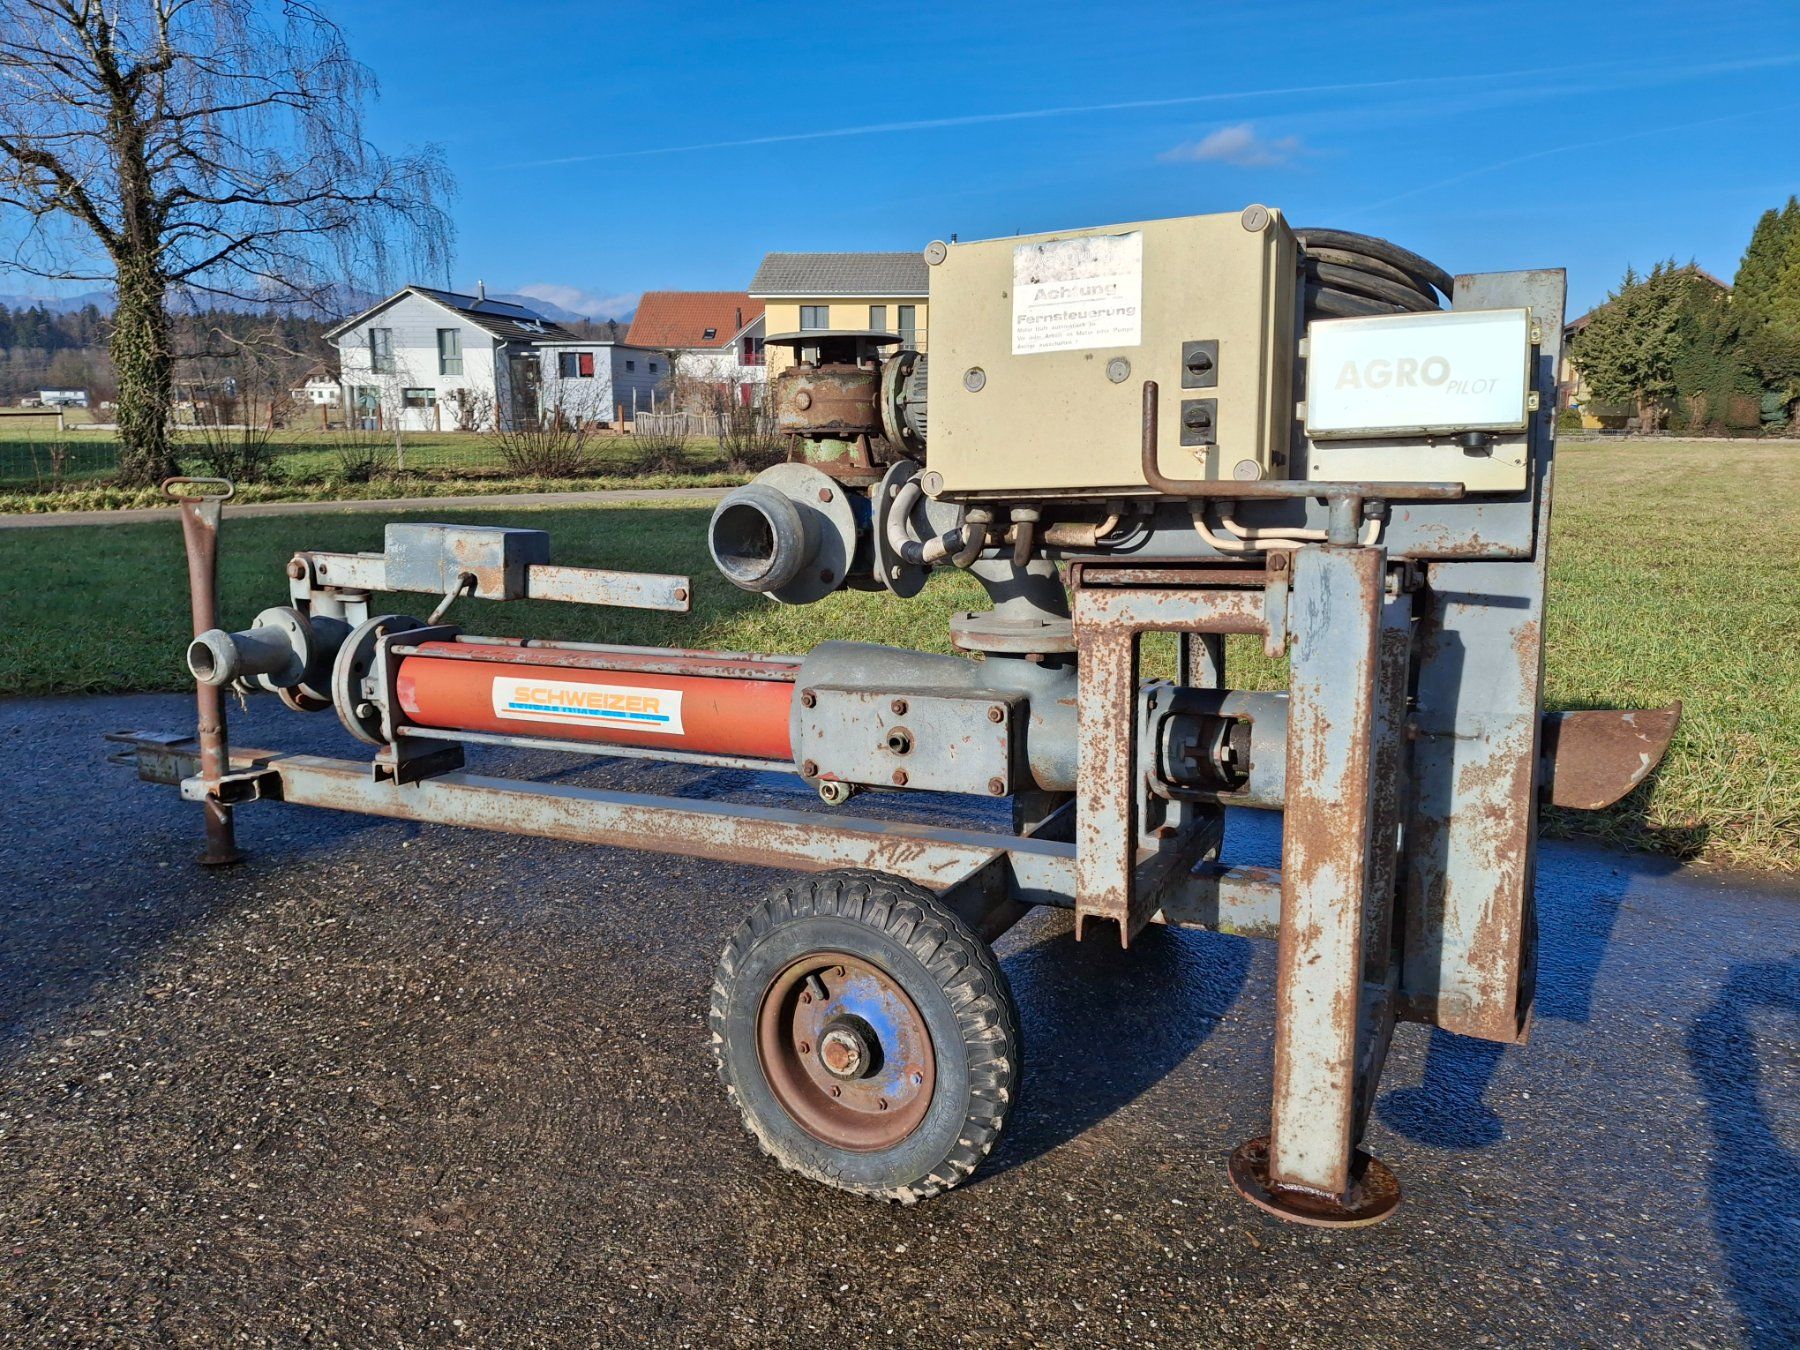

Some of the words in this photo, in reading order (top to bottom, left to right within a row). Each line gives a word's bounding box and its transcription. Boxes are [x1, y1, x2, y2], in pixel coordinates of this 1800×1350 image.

[1017, 306, 1136, 324] Fernsteuerung
[1334, 355, 1451, 391] AGRO
[1446, 377, 1500, 395] PILOT
[514, 686, 661, 714] SCHWEIZER
